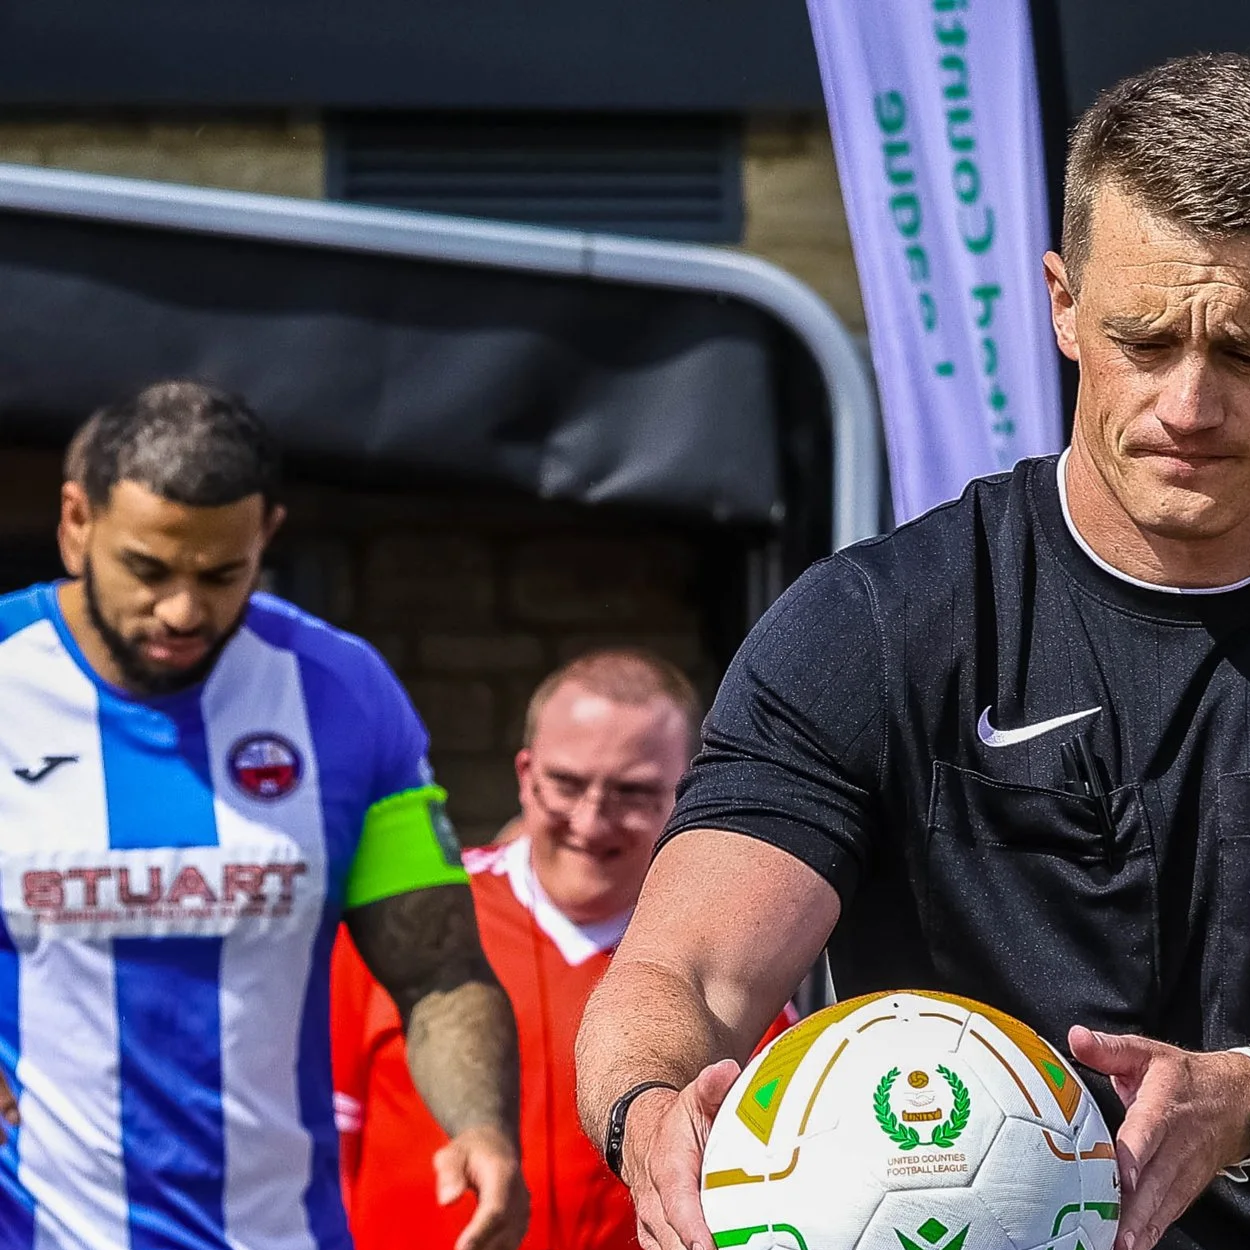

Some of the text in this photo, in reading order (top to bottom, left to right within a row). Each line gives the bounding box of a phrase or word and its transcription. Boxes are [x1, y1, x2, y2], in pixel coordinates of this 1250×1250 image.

[22, 863, 308, 908] STUART
[888, 1154, 966, 1165] UNITED COUNTIES
[887, 1164, 969, 1176] FOOTBALL LEAGUE
